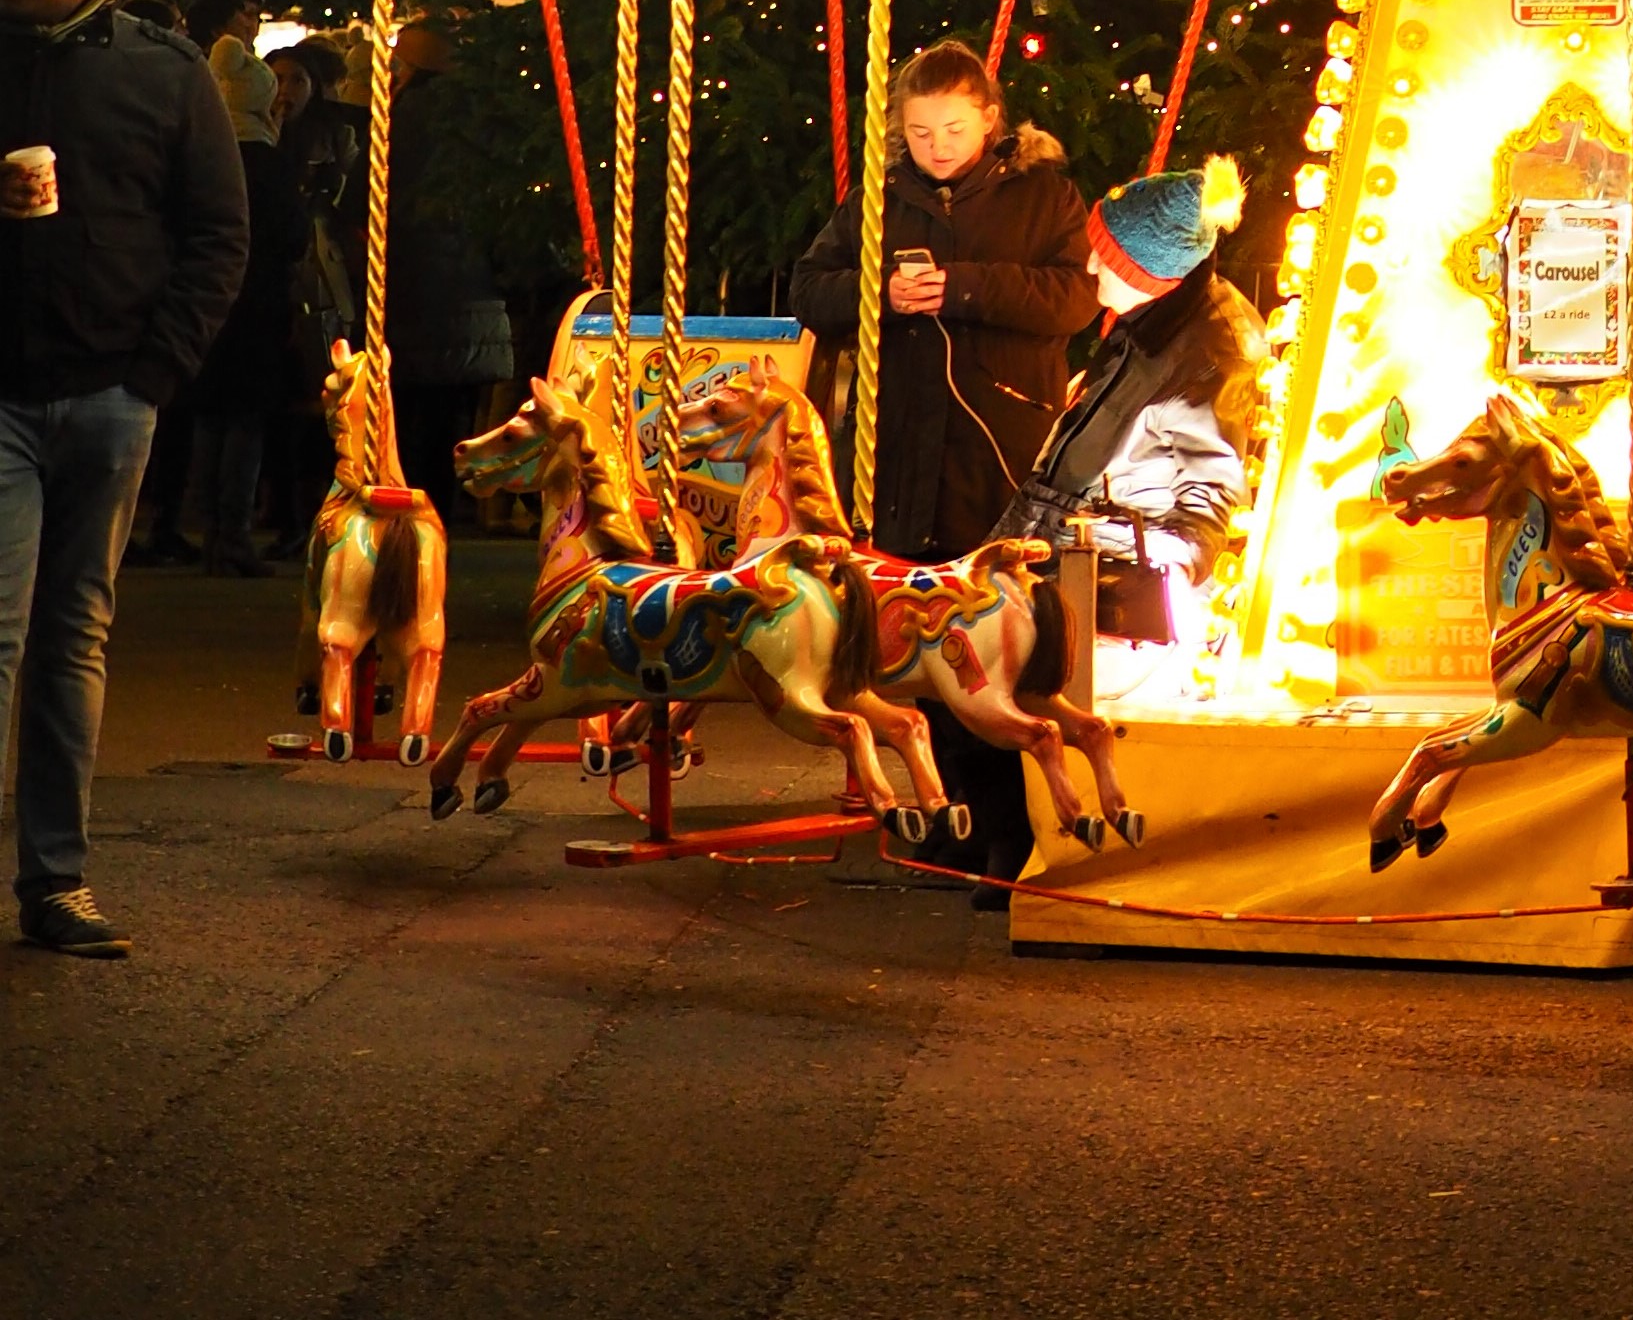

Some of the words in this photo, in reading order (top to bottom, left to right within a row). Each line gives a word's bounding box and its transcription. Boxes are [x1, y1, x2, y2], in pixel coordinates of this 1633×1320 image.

[1534, 260, 1600, 282] Carousel
[1543, 310, 1557, 320] £2
[1569, 309, 1590, 319] ride
[1370, 574, 1484, 598] THESE
[1376, 625, 1415, 647] FOR
[1384, 655, 1433, 676] FILM
[1439, 655, 1454, 675] &
[1460, 654, 1485, 675] TV
